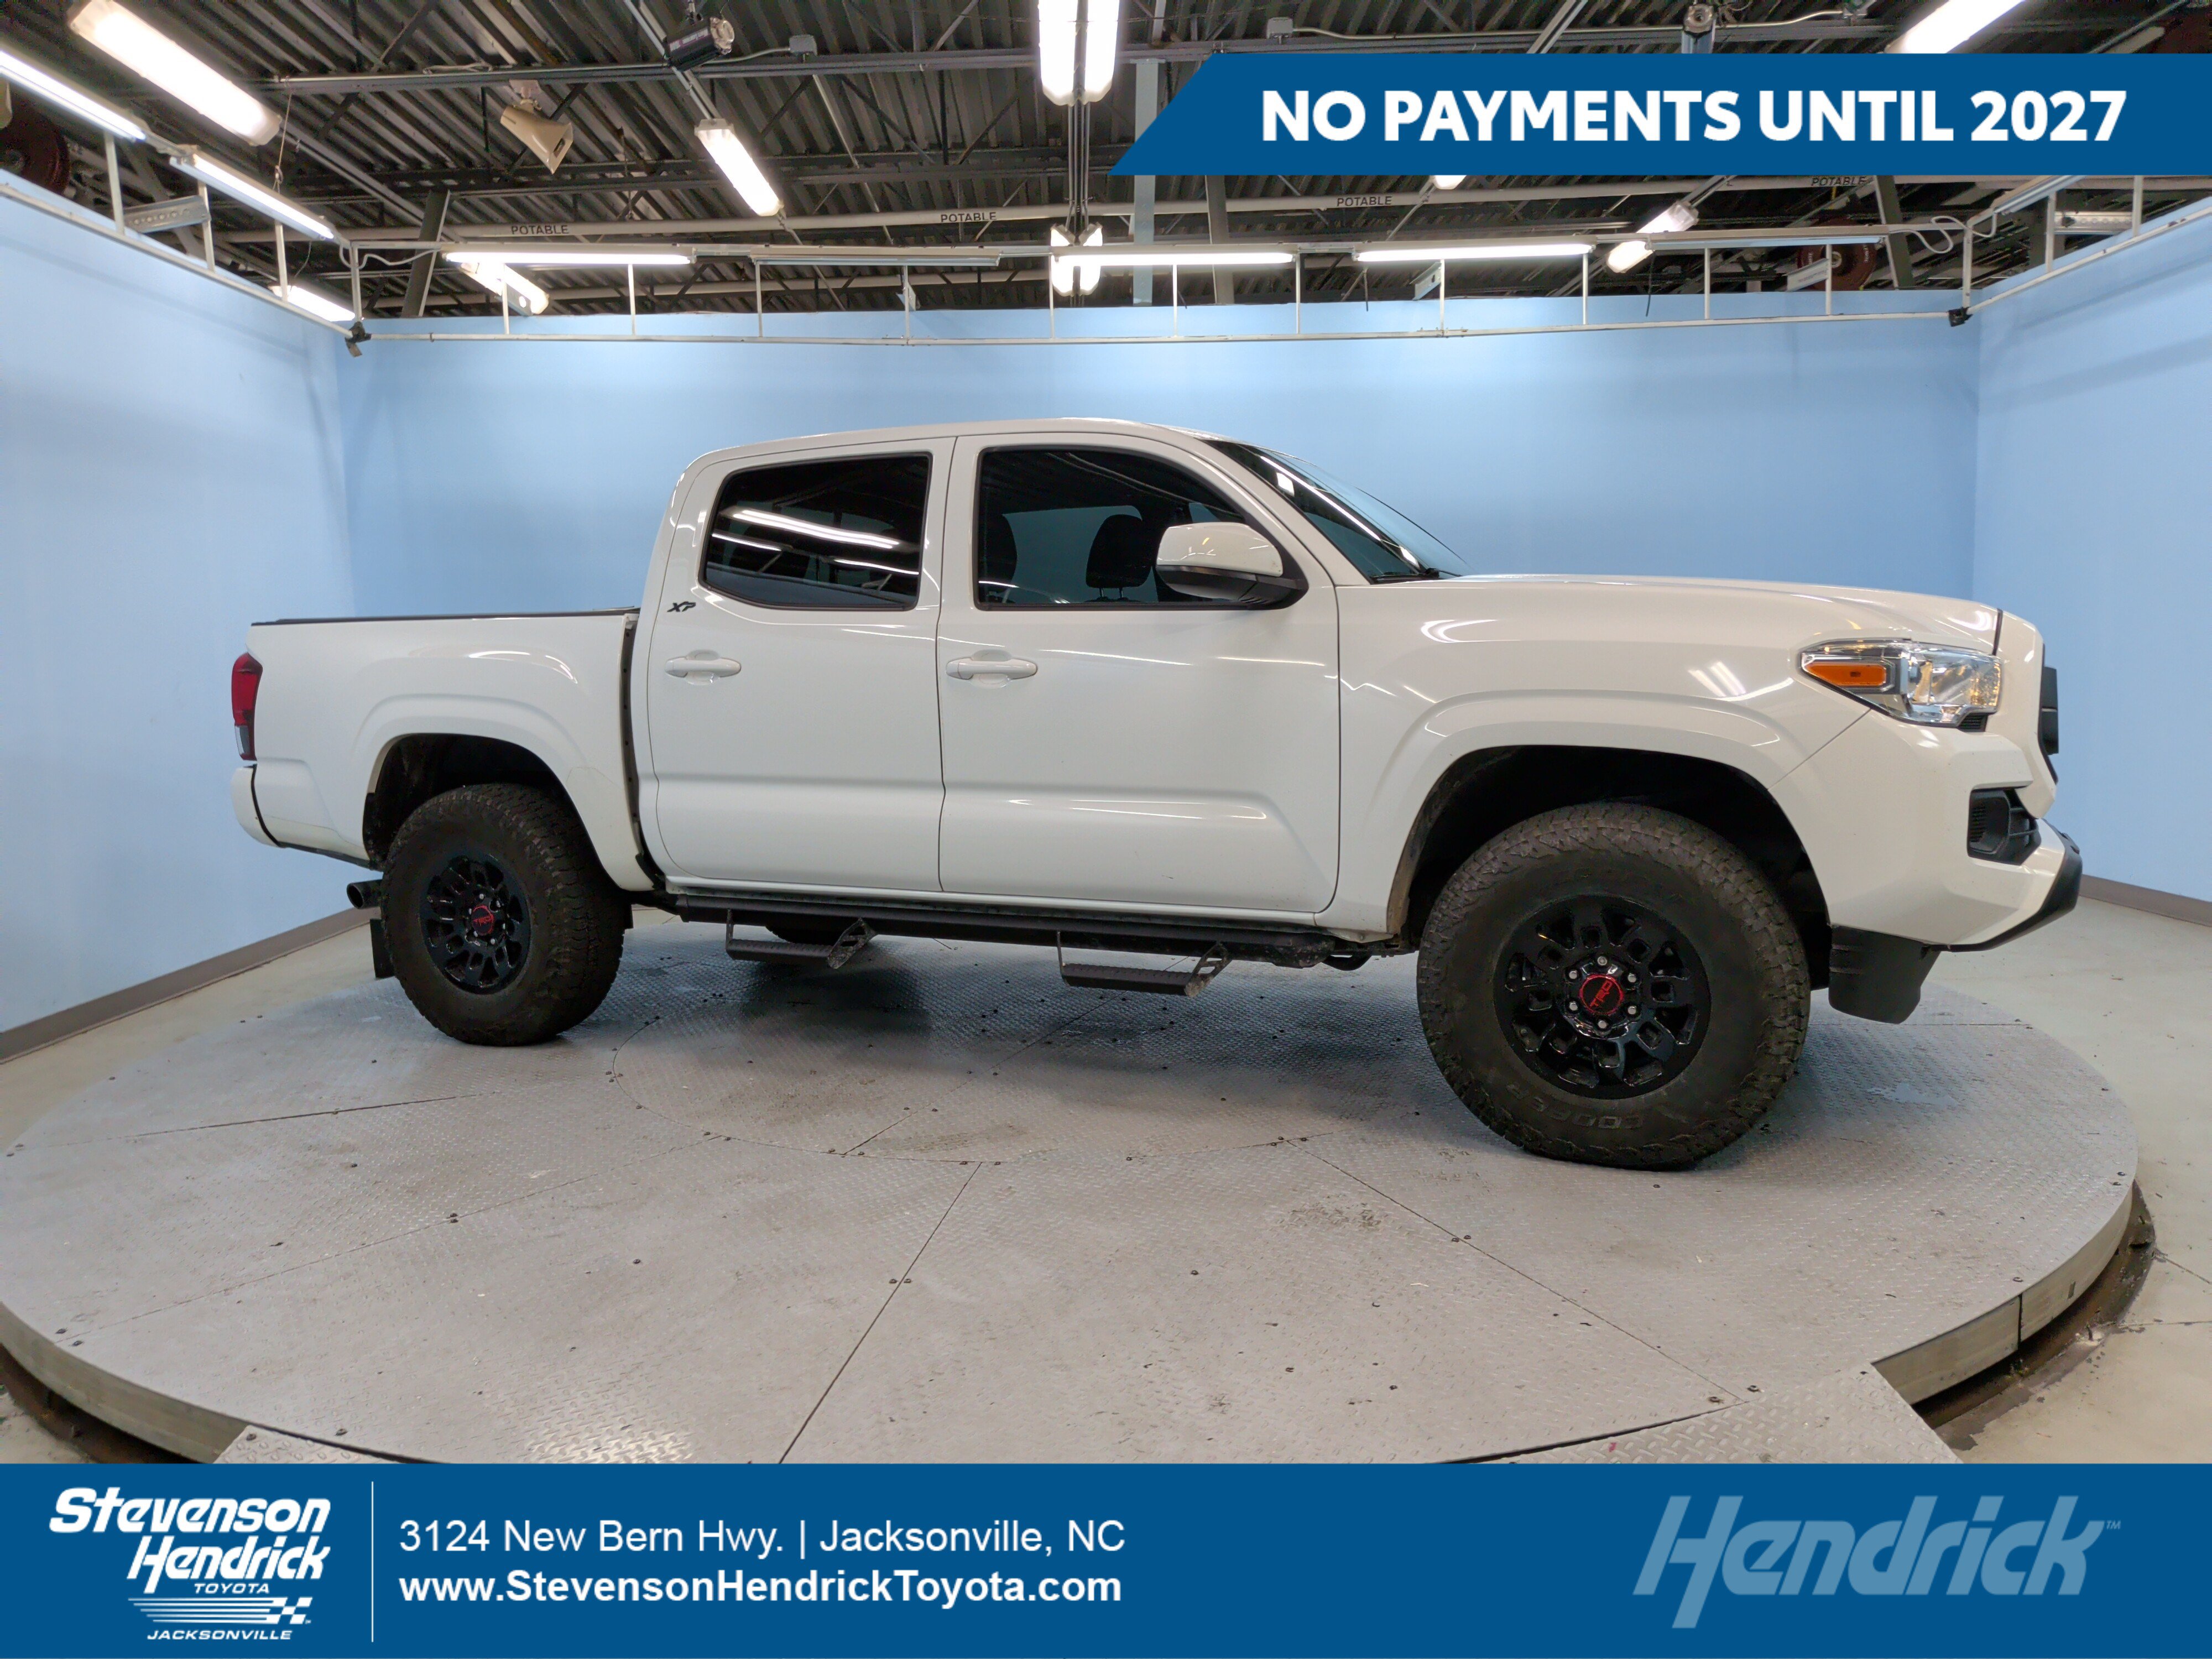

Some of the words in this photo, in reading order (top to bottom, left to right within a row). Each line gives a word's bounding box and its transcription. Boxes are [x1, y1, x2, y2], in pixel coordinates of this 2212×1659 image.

[1811, 175, 1867, 186] POTABLE
[1337, 196, 1392, 207] POTABLE
[941, 211, 997, 222] POTABLE
[511, 225, 569, 234] POTABLE
[667, 601, 696, 612] XP
[1589, 979, 1613, 1009] TRD
